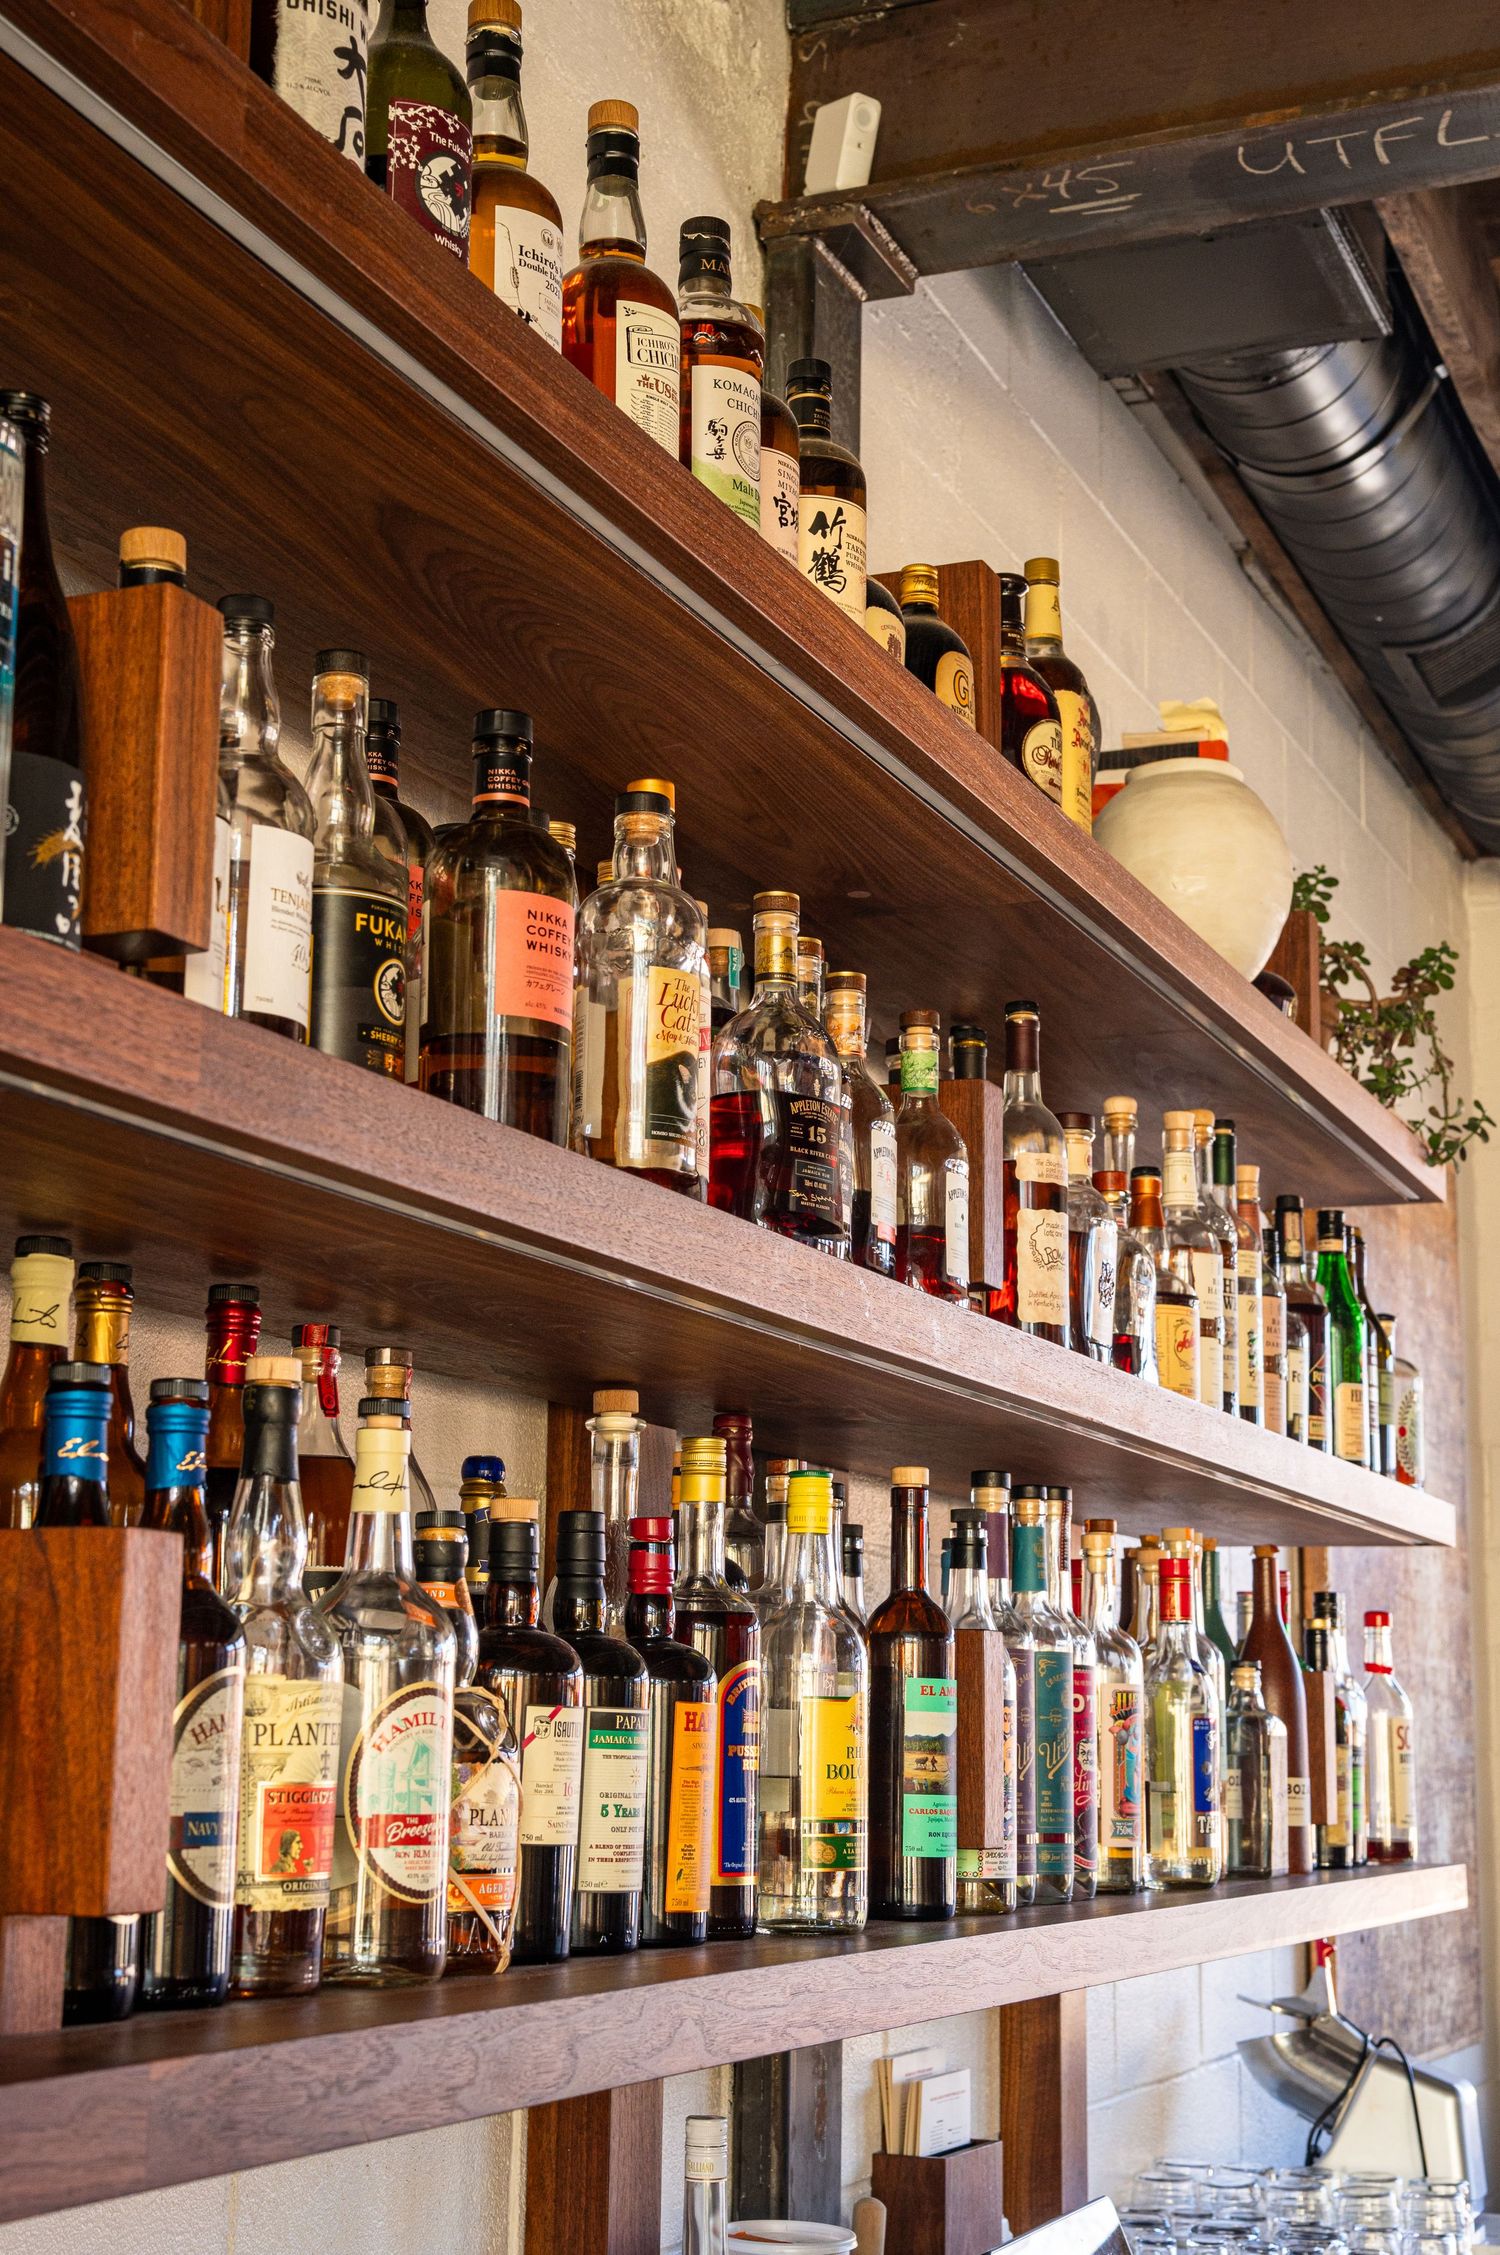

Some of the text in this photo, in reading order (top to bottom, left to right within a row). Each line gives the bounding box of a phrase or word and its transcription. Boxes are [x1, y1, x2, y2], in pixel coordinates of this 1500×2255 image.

[430, 131, 447, 147] The
[519, 244, 559, 274] Ichiro's
[519, 258, 549, 277] Double
[637, 337, 675, 351] ICHIRO'S
[636, 379, 654, 390] THE
[731, 478, 754, 498] Malt
[808, 506, 847, 593] 竹鶴
[488, 768, 516, 776] NIKKA
[488, 775, 521, 784] COFFEY
[488, 783, 522, 792] WHISKY
[527, 909, 568, 930] NIKKA
[526, 925, 572, 947] COFFEY
[526, 939, 572, 962] WHISKY
[526, 979, 565, 996] カフェグレーン
[674, 977, 690, 994] The
[661, 1004, 696, 1033] Cat
[790, 1099, 821, 1115] APPLETON
[808, 1125, 827, 1144] 15
[790, 1145, 809, 1155] BLACK
[810, 1148, 825, 1159] RIVER
[920, 1685, 936, 1696] EL
[592, 1734, 633, 1745] JAMAICA
[599, 1791, 632, 1799] ORIGINAL
[600, 1803, 609, 1818] 5
[908, 1807, 938, 1815] CARLOS
[521, 1833, 534, 1842] 750
[580, 1880, 593, 1888] 750
